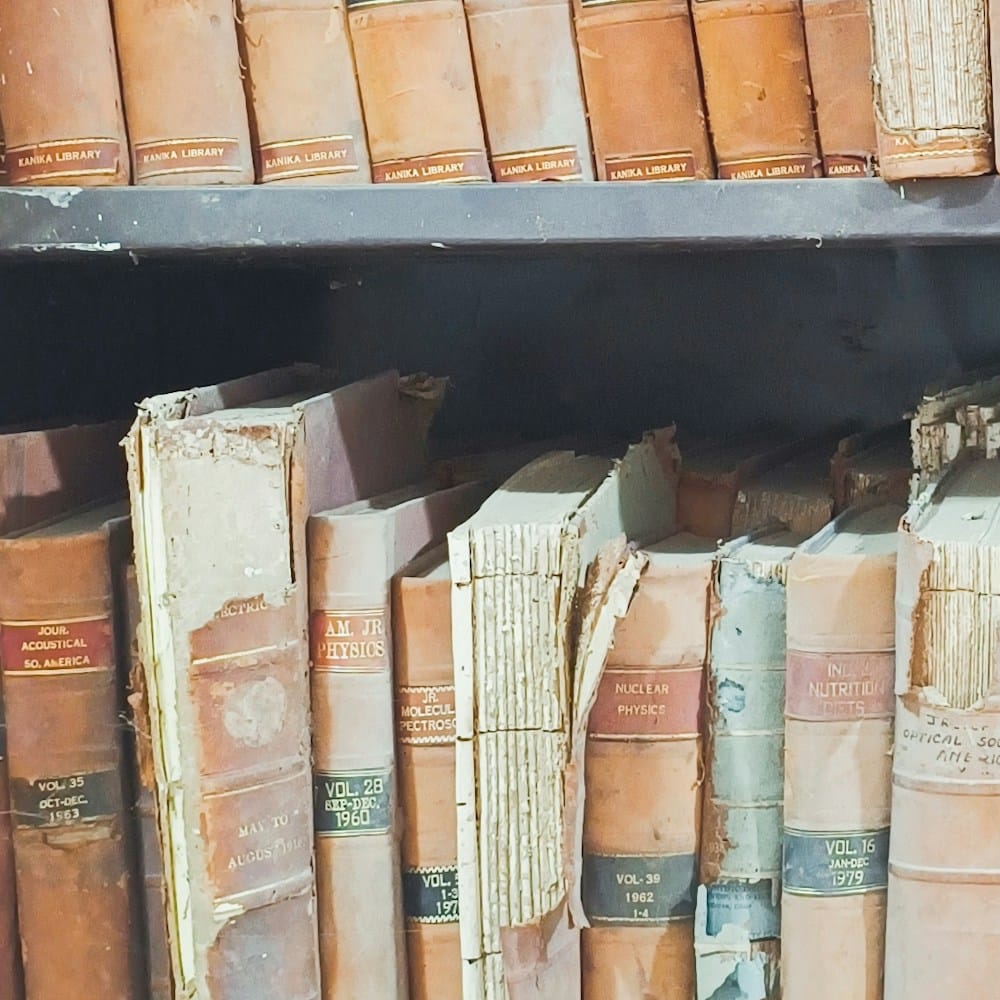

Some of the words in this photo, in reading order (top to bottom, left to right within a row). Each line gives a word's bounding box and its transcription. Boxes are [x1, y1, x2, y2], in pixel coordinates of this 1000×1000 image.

[18, 151, 53, 168] KANIKA
[55, 149, 101, 162] LIBRARY
[143, 150, 178, 164] KANIKA
[181, 147, 225, 159] LIBRARY
[265, 154, 300, 169] KANIKA
[304, 149, 348, 163] LIBRARY
[384, 168, 420, 182] KANIKA
[422, 162, 465, 176] LIBRARY
[500, 162, 534, 177] KANIKA
[535, 158, 576, 172] LIBRARY
[610, 168, 643, 181] KANIKA
[646, 163, 688, 177] LIBRARY
[765, 163, 806, 178] LIBRARY
[37, 625, 70, 637] JOUR.
[21, 638, 88, 652] ACOUSTICAL
[318, 640, 385, 660] PHYSICS
[23, 657, 43, 669] SO.
[44, 655, 91, 669] AMERICA
[615, 683, 670, 695] NUCLEAR
[809, 680, 886, 698] NUTRITION
[617, 704, 667, 716] PHYSICS
[68, 776, 85, 789] 35
[325, 779, 360, 798] VOL.
[49, 808, 81, 823] 1963
[334, 809, 371, 828] 1960
[825, 839, 858, 855] VOL.
[861, 838, 876, 854] 16
[831, 869, 864, 886] 1979
[625, 891, 655, 903] 1962
[633, 908, 649, 918] 1-4
